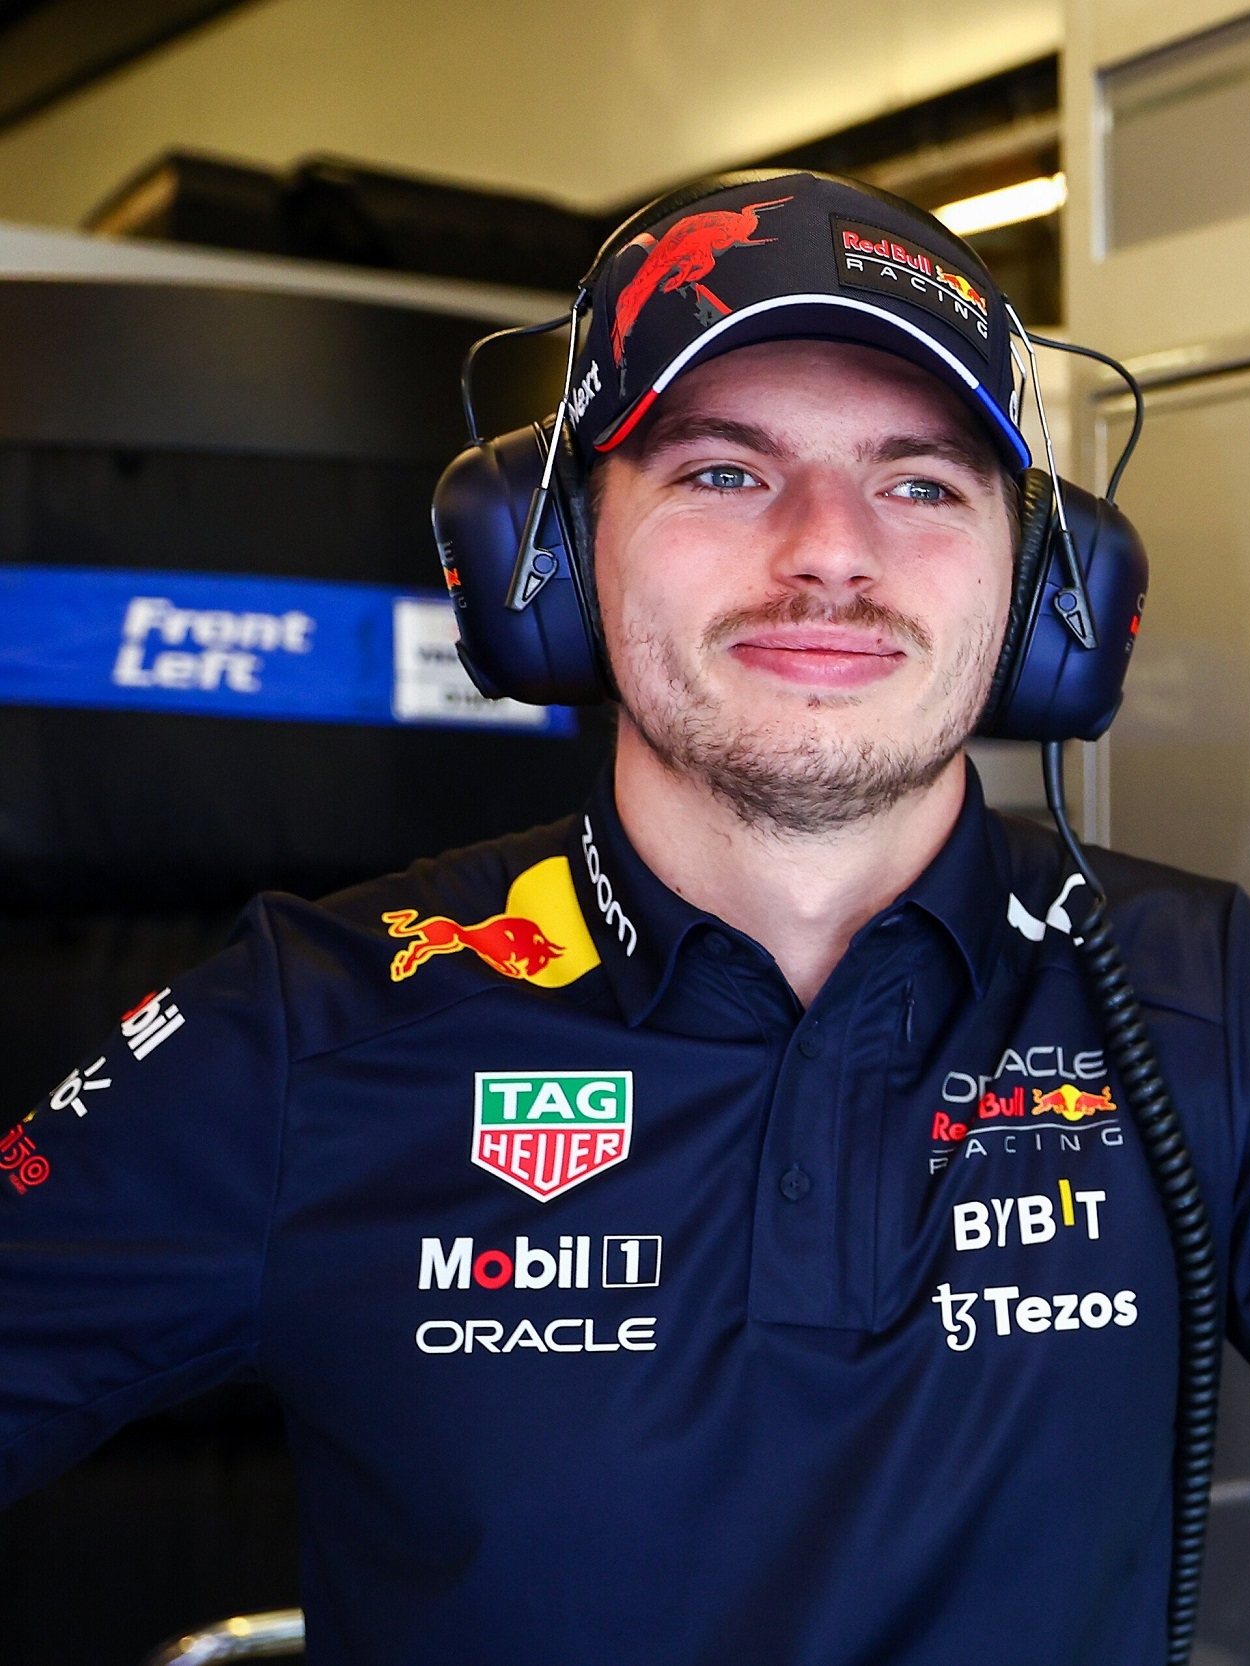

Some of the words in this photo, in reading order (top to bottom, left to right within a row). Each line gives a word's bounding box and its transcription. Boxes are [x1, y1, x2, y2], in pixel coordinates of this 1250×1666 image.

[842, 230, 890, 259] Red
[890, 243, 933, 277] Bull
[845, 257, 988, 340] RACING
[122, 596, 314, 652] Front
[114, 645, 262, 693] Left
[581, 814, 637, 957] zoom
[488, 1081, 617, 1120] TAG
[931, 1111, 968, 1142] Re
[977, 1086, 1025, 1119] Bull
[481, 1132, 620, 1192] HEUER
[953, 1178, 1106, 1251] BYBIT
[418, 1236, 590, 1290] Mobil
[415, 1317, 658, 1354] ORACLE
[983, 1286, 1138, 1336] Tezos
